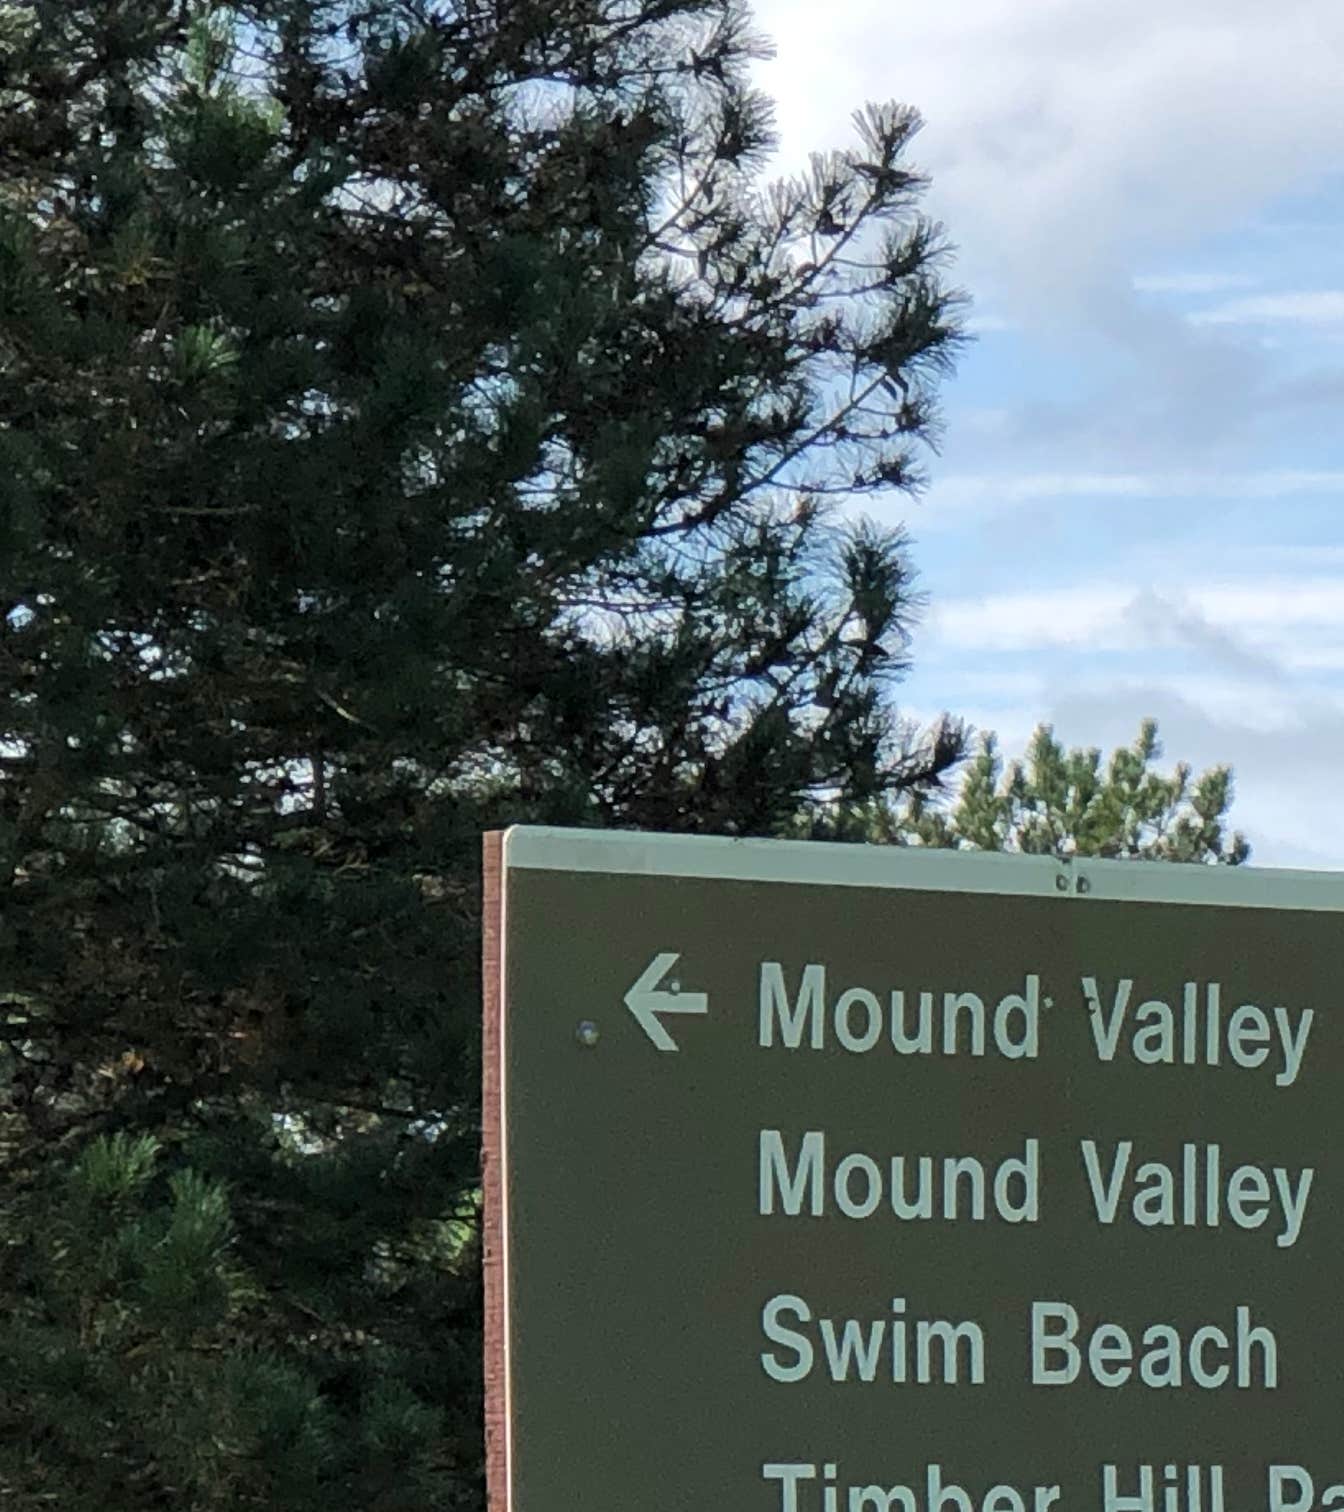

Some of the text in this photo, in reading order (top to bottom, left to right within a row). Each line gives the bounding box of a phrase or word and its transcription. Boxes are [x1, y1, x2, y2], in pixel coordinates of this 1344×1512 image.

[759, 961, 1040, 1059] Mound
[1082, 977, 1315, 1087] Valley
[759, 1129, 1039, 1223] Mound
[1081, 1140, 1314, 1248] Valley
[761, 1294, 985, 1384] Swim
[1031, 1301, 1277, 1388] Beach
